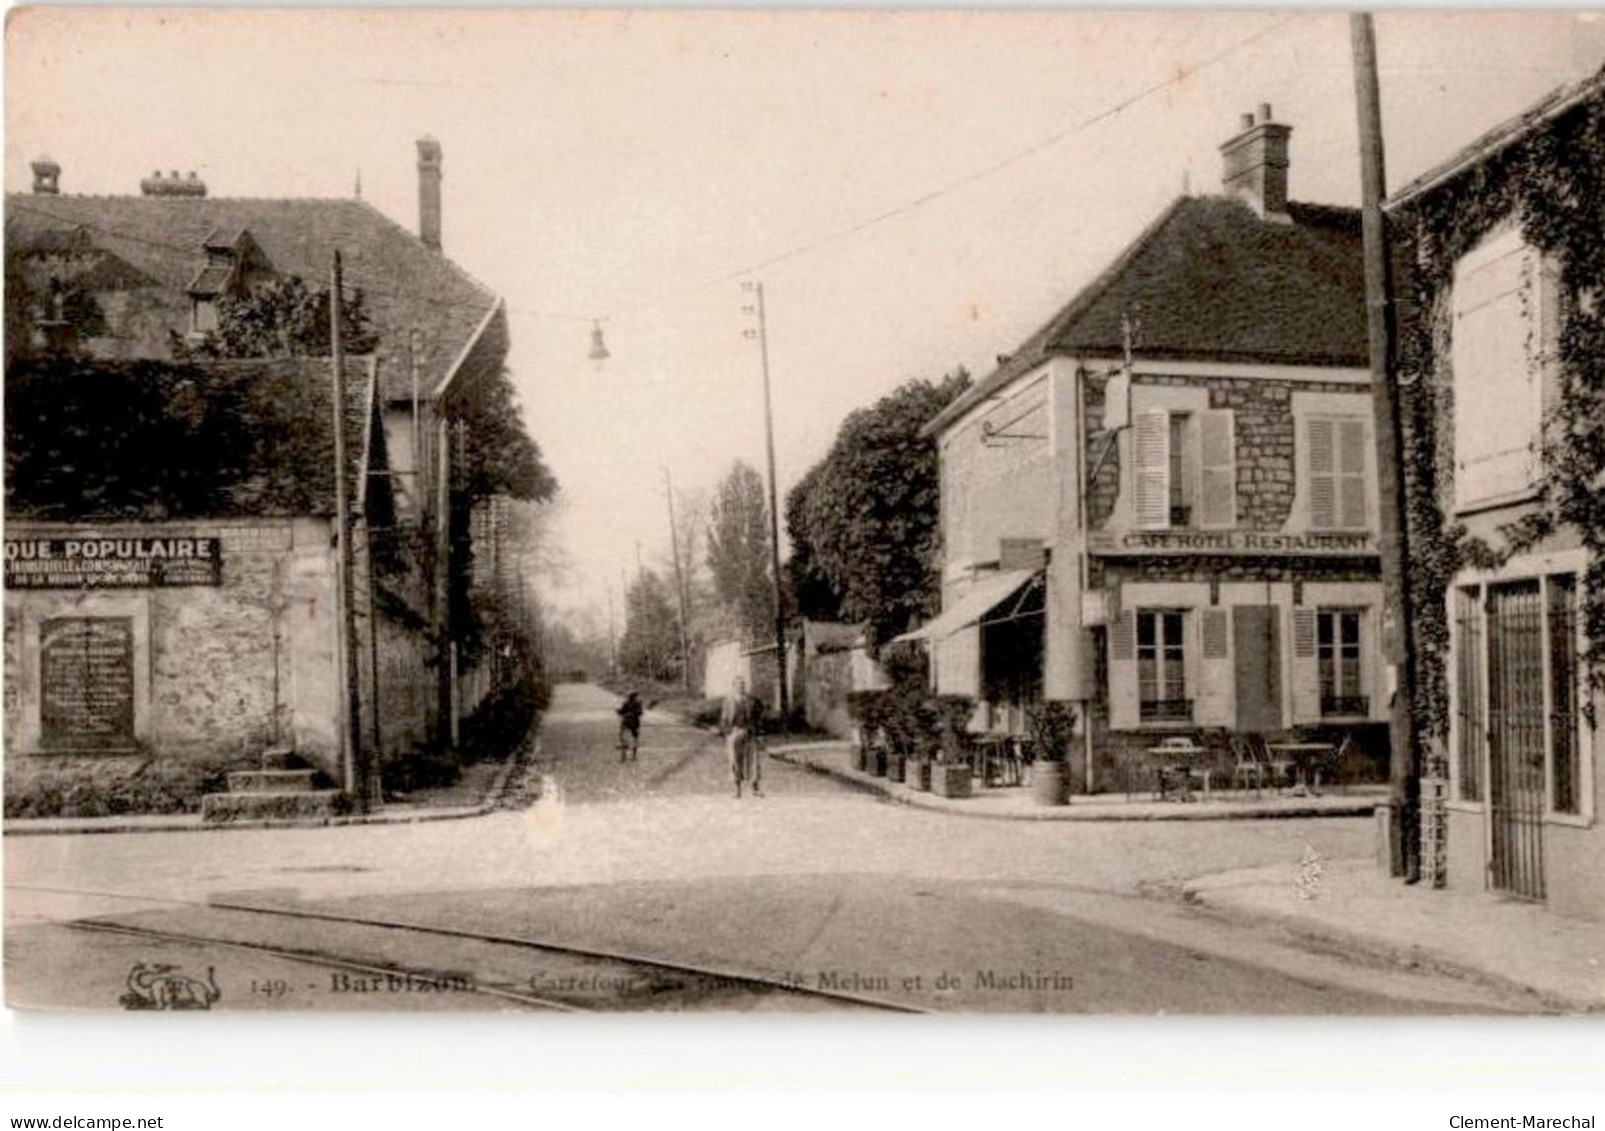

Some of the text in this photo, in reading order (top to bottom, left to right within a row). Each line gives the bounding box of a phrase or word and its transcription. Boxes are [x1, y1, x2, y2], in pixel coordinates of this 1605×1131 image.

[5, 540, 213, 560] QUE POPULAIRE
[1245, 534, 1370, 549] RESTAURANT
